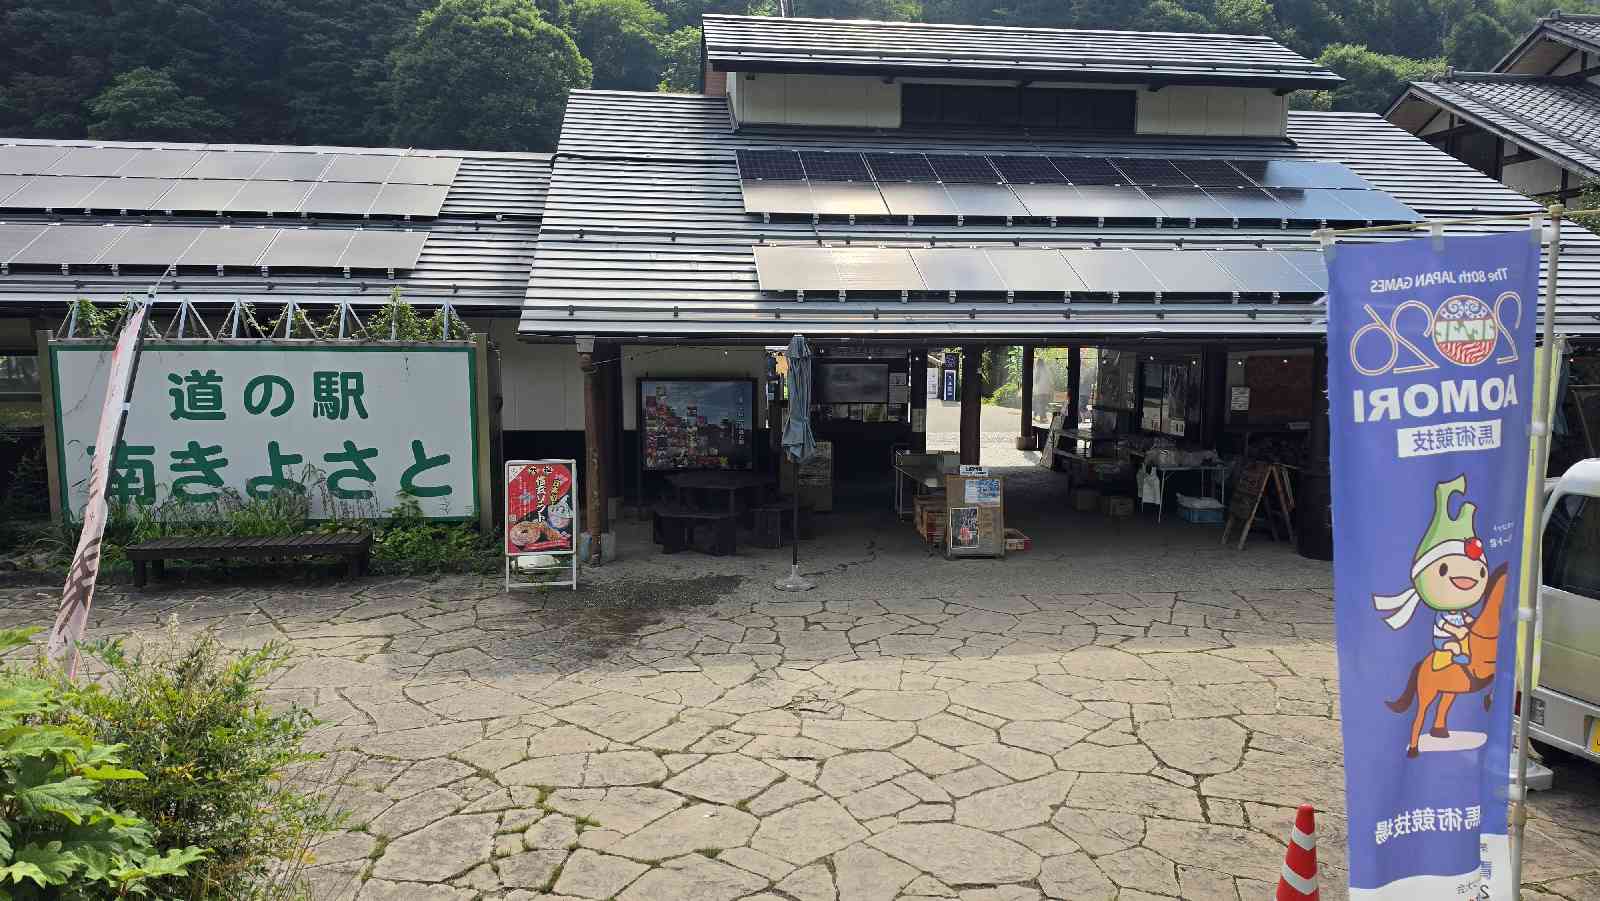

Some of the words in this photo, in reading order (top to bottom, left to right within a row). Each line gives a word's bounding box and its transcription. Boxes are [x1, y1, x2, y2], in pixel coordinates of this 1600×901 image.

[167, 369, 369, 421] 道の駅
[87, 439, 452, 505] 南きよさと
